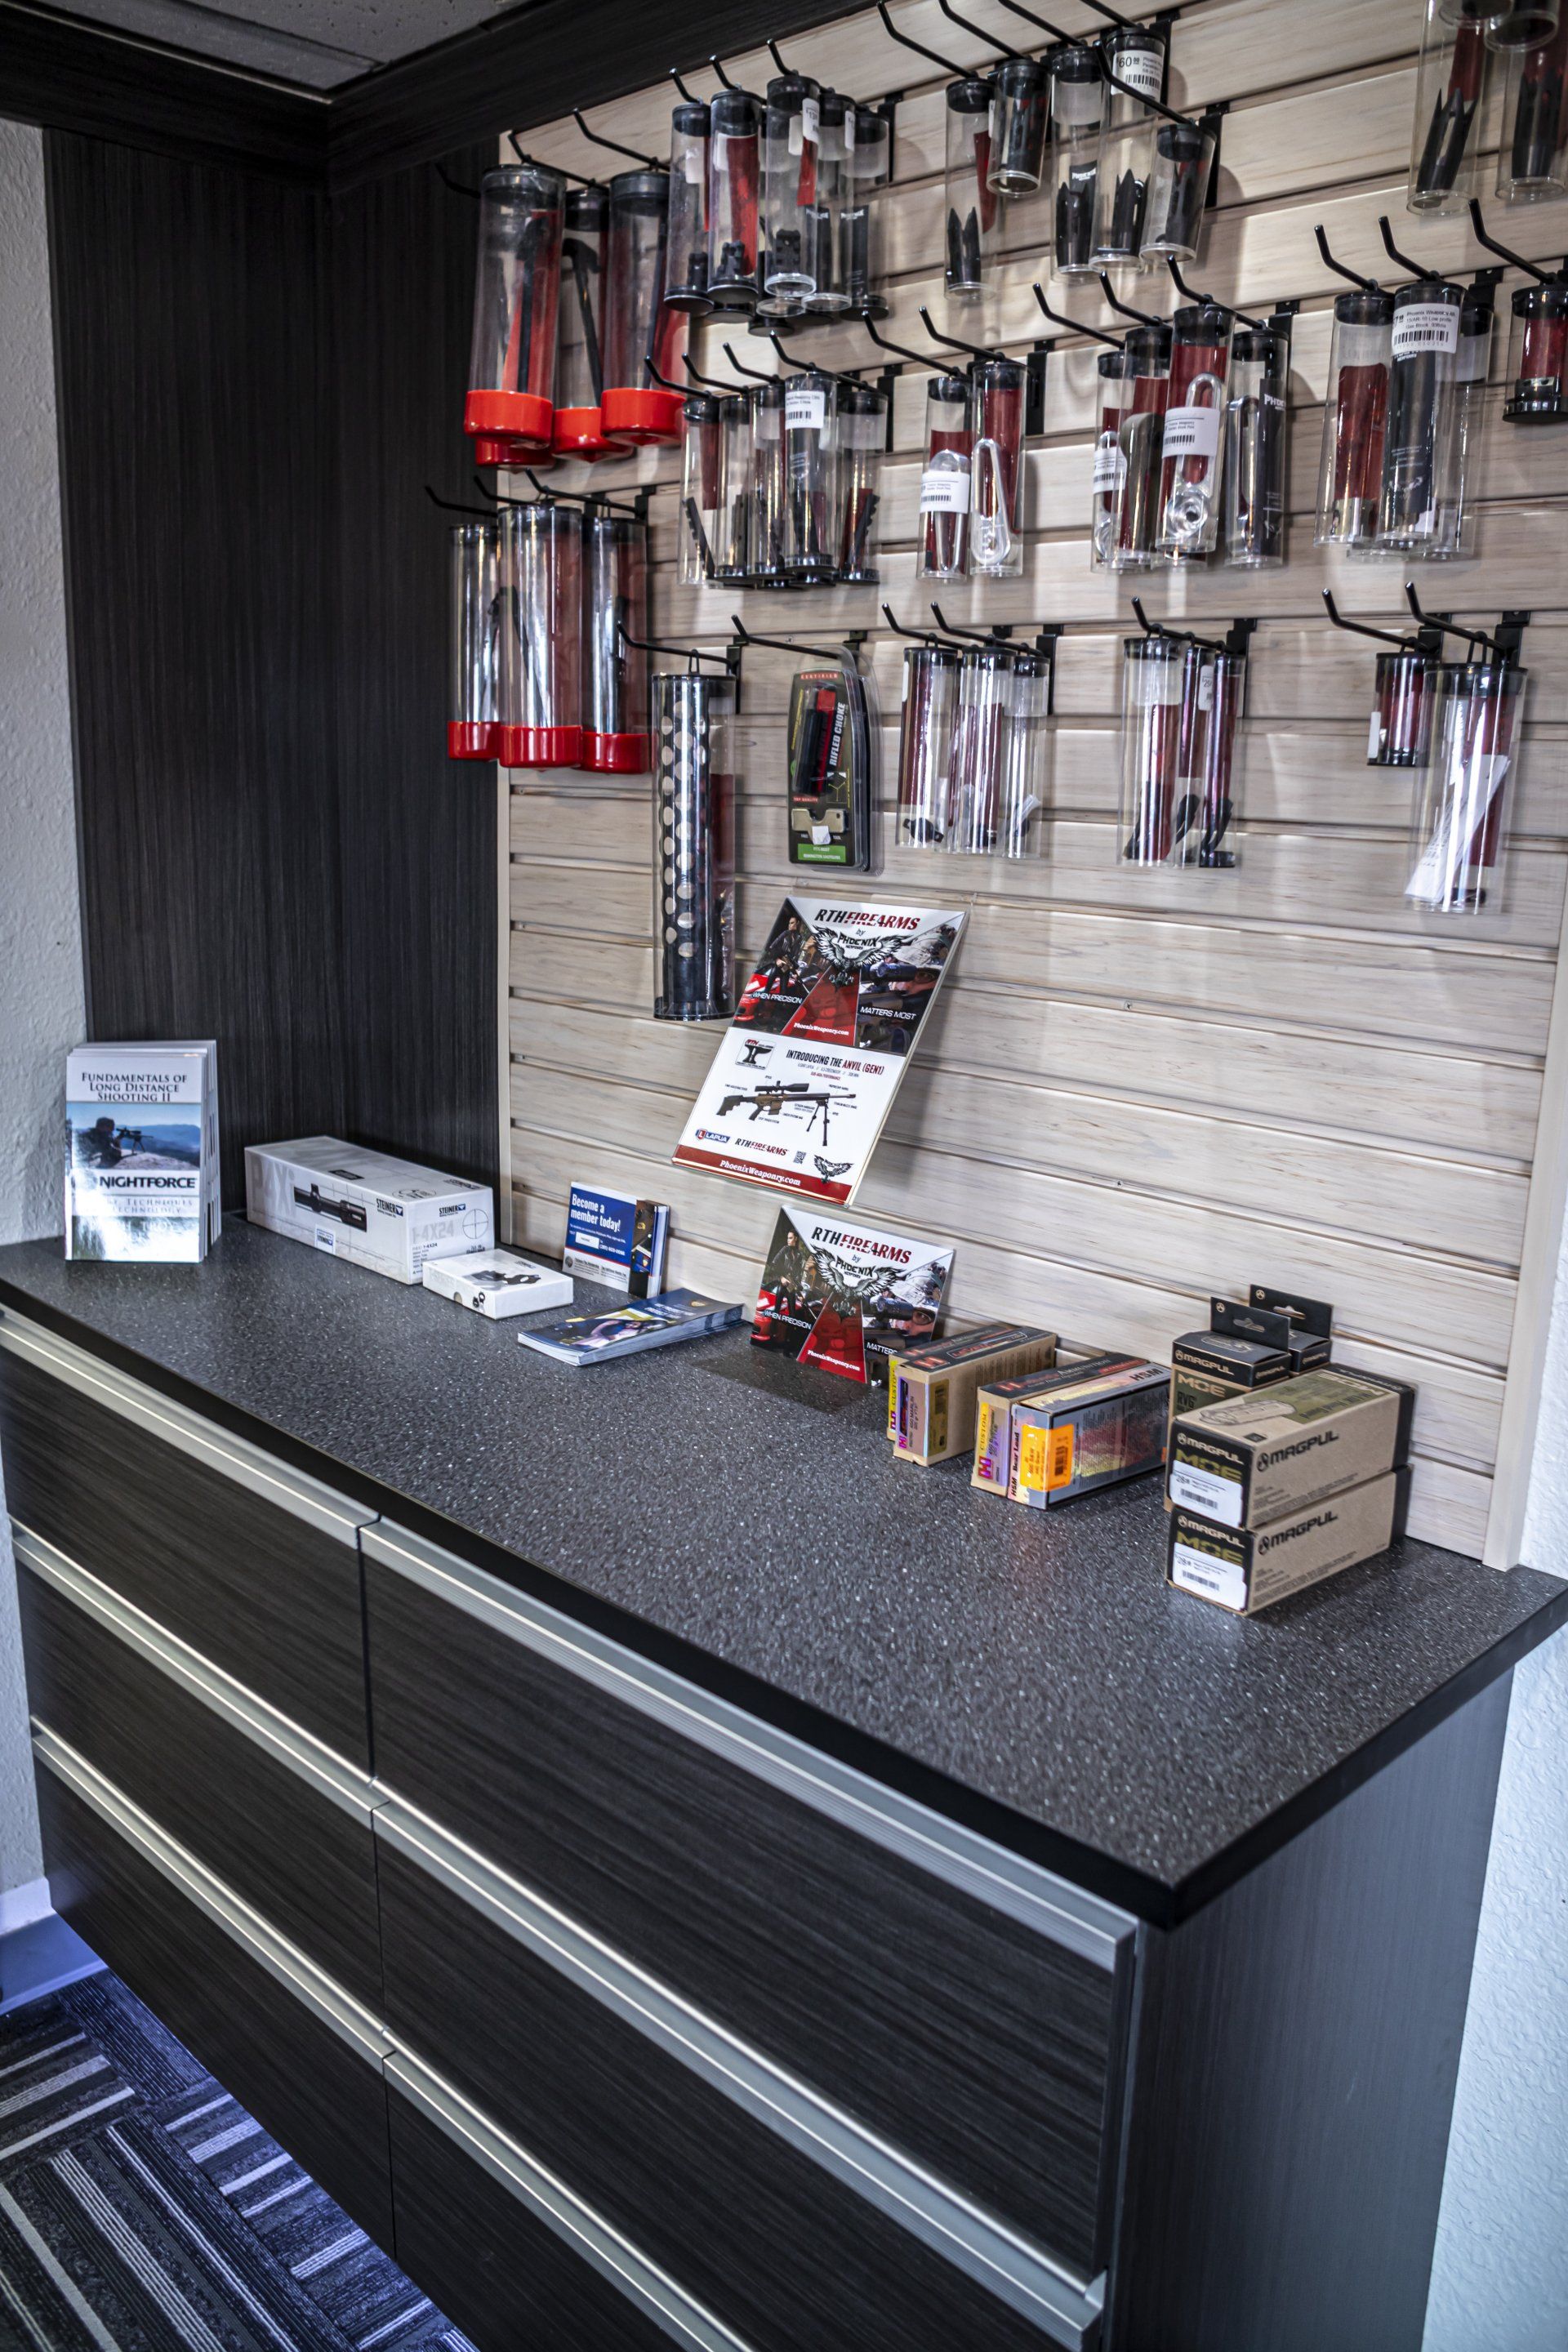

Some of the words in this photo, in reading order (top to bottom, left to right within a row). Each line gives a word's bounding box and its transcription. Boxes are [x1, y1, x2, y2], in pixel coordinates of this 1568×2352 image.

[834, 702, 846, 733] CHOKE
[829, 734, 841, 767] RIFLED
[837, 932, 881, 947] PHOENIX
[855, 928, 866, 937] by
[752, 991, 769, 1001] WHEN
[769, 994, 803, 1004] PRECISION
[860, 1005, 893, 1018] MATTERS
[894, 1010, 916, 1020] MOST
[793, 1022, 849, 1036] PhoenixWeaponry.com
[786, 1049, 830, 1065] INTRODUCING
[830, 1058, 843, 1067] THE
[842, 1059, 862, 1071] ANVIL
[90, 1083, 120, 1092] LONG
[125, 1084, 180, 1093] DISTANCE
[97, 1093, 158, 1102] SHOOTING
[706, 1132, 728, 1143] LAPUA
[99, 1176, 197, 1189] NIGHTFORCE
[719, 1160, 800, 1186] PhoenixWeaponry.com
[376, 1198, 397, 1214] STEINER
[439, 1204, 459, 1215] STEINER
[572, 1193, 599, 1212] Become
[599, 1205, 604, 1214] a
[570, 1209, 599, 1226] member
[599, 1214, 621, 1232] today!
[835, 1255, 876, 1277] PHOENIX
[851, 1254, 862, 1263] by
[764, 1309, 783, 1321] WHEN
[782, 1314, 812, 1330] PRECISION
[1129, 1368, 1164, 1381] HSM
[1183, 1353, 1235, 1376] MAGPUL
[1177, 1373, 1226, 1398] MOE
[980, 1414, 988, 1450] CUSTOM
[1187, 1437, 1245, 1464] MAGPUL
[1271, 1431, 1339, 1465] MAGPUL
[1187, 1520, 1245, 1548] MAGPUL
[1271, 1512, 1339, 1547] MAGPUL
